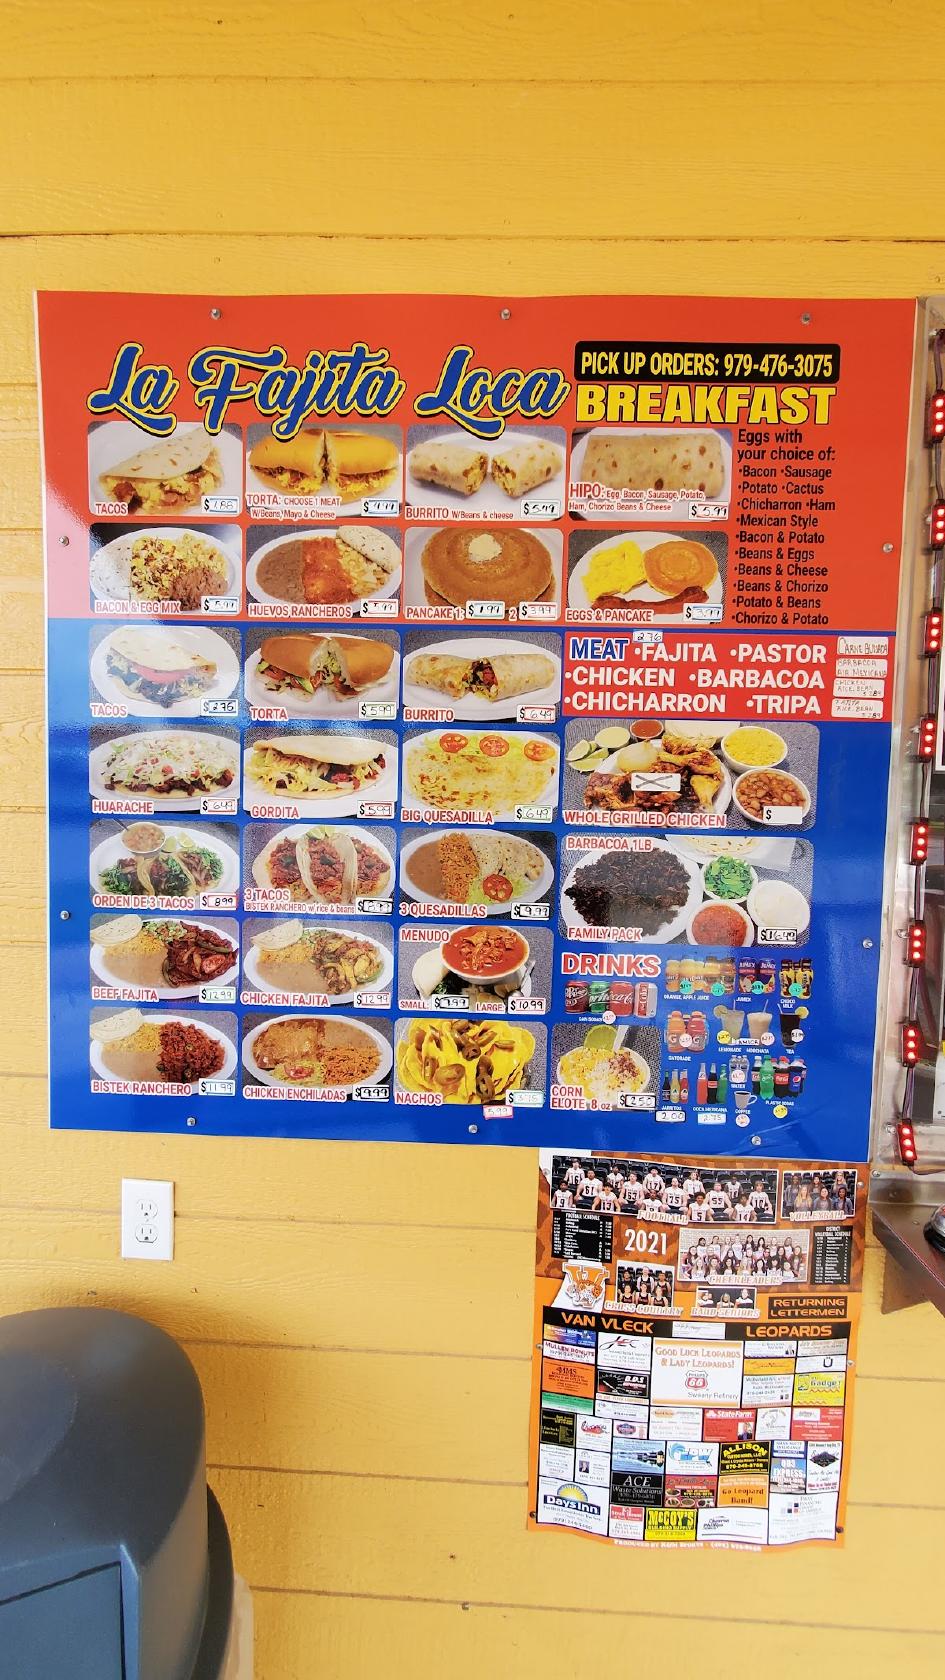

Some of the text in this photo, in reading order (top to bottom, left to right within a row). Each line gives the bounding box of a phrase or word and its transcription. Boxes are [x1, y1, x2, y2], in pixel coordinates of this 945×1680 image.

[581, 352, 833, 378] PICK UP ORDERS: 979-476-3075
[87, 342, 572, 442] La Fajita Loca
[576, 384, 836, 425] BREAKFAST
[738, 429, 802, 446] Eggs with
[737, 447, 836, 463] your choice of:
[570, 483, 604, 498] HIPO:
[247, 494, 341, 506] TORTA: CHOOSE MEAT
[95, 503, 127, 515] TACOS
[406, 507, 449, 518] BURRITO
[489, 511, 514, 520] cheese
[589, 503, 614, 511] Chorizo
[616, 503, 637, 511] Beans
[646, 503, 672, 511] Cheese
[284, 509, 303, 519] Mayo
[310, 510, 335, 518] Cheese
[790, 514, 819, 530] Style
[777, 531, 785, 543] &
[789, 531, 825, 544] Potato
[776, 548, 784, 560] &
[788, 548, 815, 562] Eggs
[775, 564, 783, 576] &
[787, 564, 828, 576] Cheese
[774, 580, 782, 592] &
[786, 580, 829, 592] Chorizo
[95, 601, 180, 614] BACON & EGG MIX
[776, 596, 784, 608] &
[788, 596, 821, 608] Beans
[250, 606, 351, 617] HUEVOS RANCHEROS
[406, 608, 454, 619] PANCAKE
[566, 610, 652, 622] EGGS & PANCAKE
[781, 613, 789, 625] &
[793, 613, 829, 625] Potato
[570, 637, 629, 661] MEAT
[91, 704, 127, 716] TACOS
[251, 707, 288, 720] TORTA
[405, 708, 454, 721] BURRITO
[93, 801, 153, 813] HUARACHE
[251, 805, 299, 818] GORDITA
[402, 810, 493, 823] BIG QUESADILLA
[564, 811, 727, 827] WHOLE GRILLED CHICKEN
[567, 837, 629, 850] BARBACOA
[245, 889, 290, 900] 3 TACOS
[94, 895, 194, 909] ORDEN DE 3 TACOS
[245, 903, 269, 911] BISTEK
[270, 903, 307, 912] RANCHERO
[336, 905, 355, 913] beans
[400, 904, 486, 917] 3 QUESADILLAS
[401, 929, 450, 942] MENUDO
[568, 927, 642, 941] FAMILY PACK
[561, 953, 661, 977] DRINKS
[93, 987, 157, 1000] BEEF FAJITA
[242, 993, 329, 1006] CHICKEN FAJITA
[400, 1001, 505, 1012] SMALL: LARGE:
[93, 1081, 191, 1095] BISTEK RANCHERO
[244, 1087, 346, 1101] CHICKEN ENCHILADAS
[551, 1086, 583, 1097] CORN
[396, 1092, 442, 1104] NACHOS
[551, 1097, 585, 1109] ELOTE
[591, 1099, 598, 1110] 8
[624, 1229, 667, 1255] 2021
[709, 1275, 783, 1285] CHEERLEADERS
[773, 1299, 845, 1307] RETURNING
[770, 1308, 845, 1316] LETTERMEN
[561, 1312, 596, 1327] VAN
[601, 1317, 655, 1333] VLECK
[746, 1325, 832, 1338] LEOPARDS
[688, 1378, 705, 1388] 66
[723, 1443, 768, 1459] ALLISON
[623, 1475, 652, 1487] ACE
